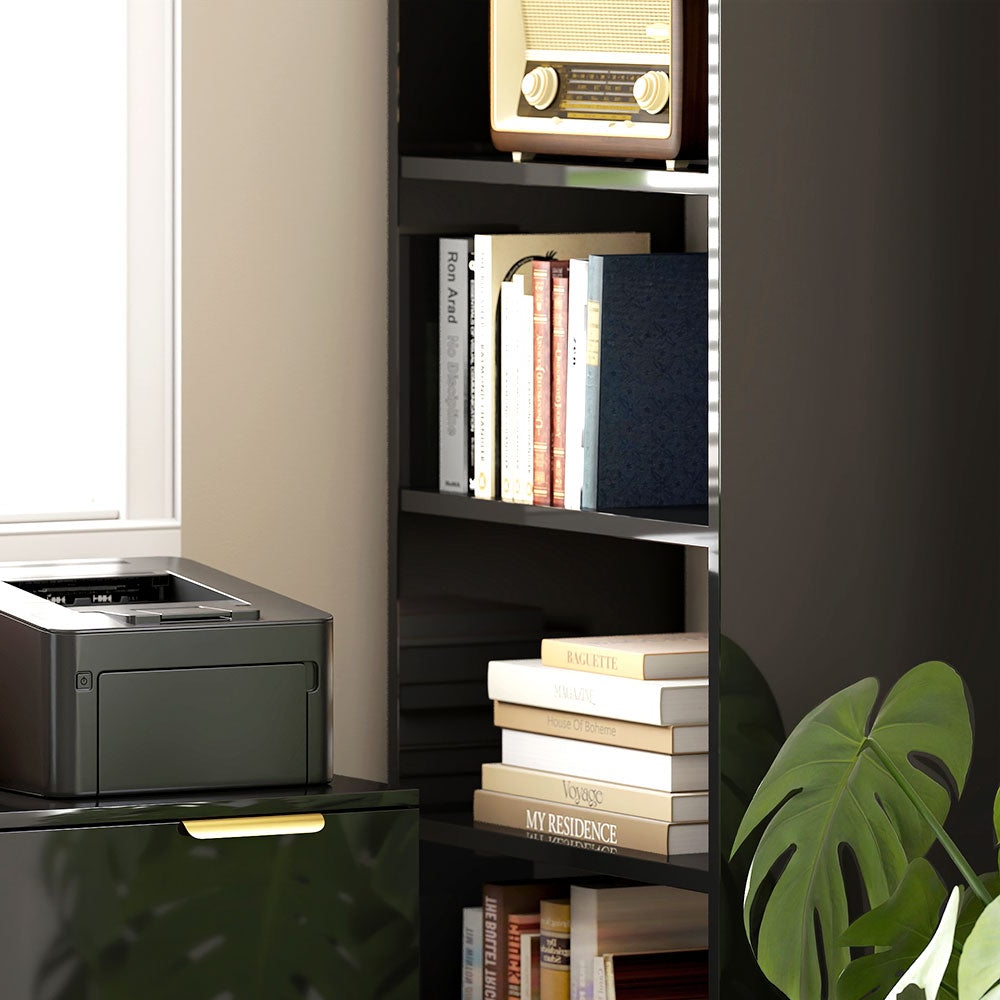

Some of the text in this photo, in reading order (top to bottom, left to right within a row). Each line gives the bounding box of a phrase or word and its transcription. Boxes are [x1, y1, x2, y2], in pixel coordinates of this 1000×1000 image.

[445, 251, 458, 436] Ron Arad No Discipline
[566, 650, 618, 670] BAGUETTE
[547, 715, 617, 737] House Of Boheme
[562, 780, 603, 808] Voyage
[526, 809, 618, 844] MY RESIDENCE
